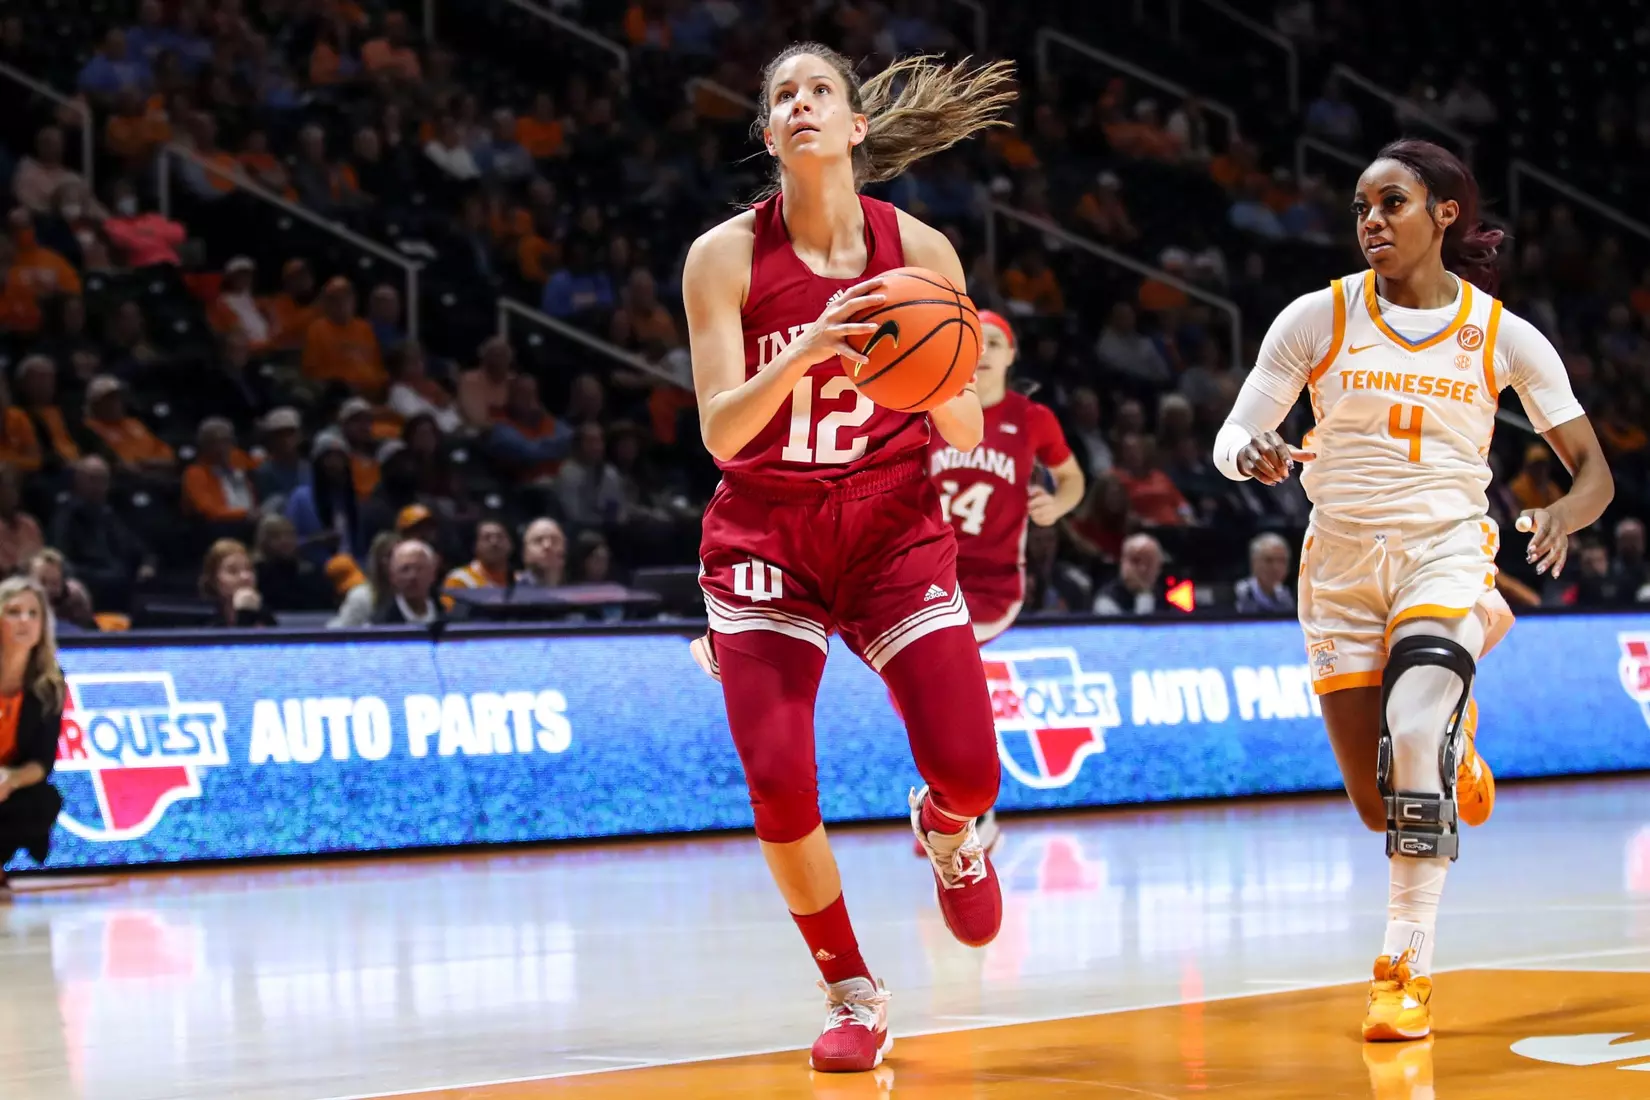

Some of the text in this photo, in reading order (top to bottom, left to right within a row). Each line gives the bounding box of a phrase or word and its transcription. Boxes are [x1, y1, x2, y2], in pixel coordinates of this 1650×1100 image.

[1339, 370, 1479, 404] TENNESSEE
[782, 375, 874, 464] 12
[1387, 403, 1424, 463] 4
[931, 445, 1015, 484] INDIANA
[1131, 667, 1230, 726] AUTO
[57, 690, 572, 765] RQUEST AUTO PARTS
